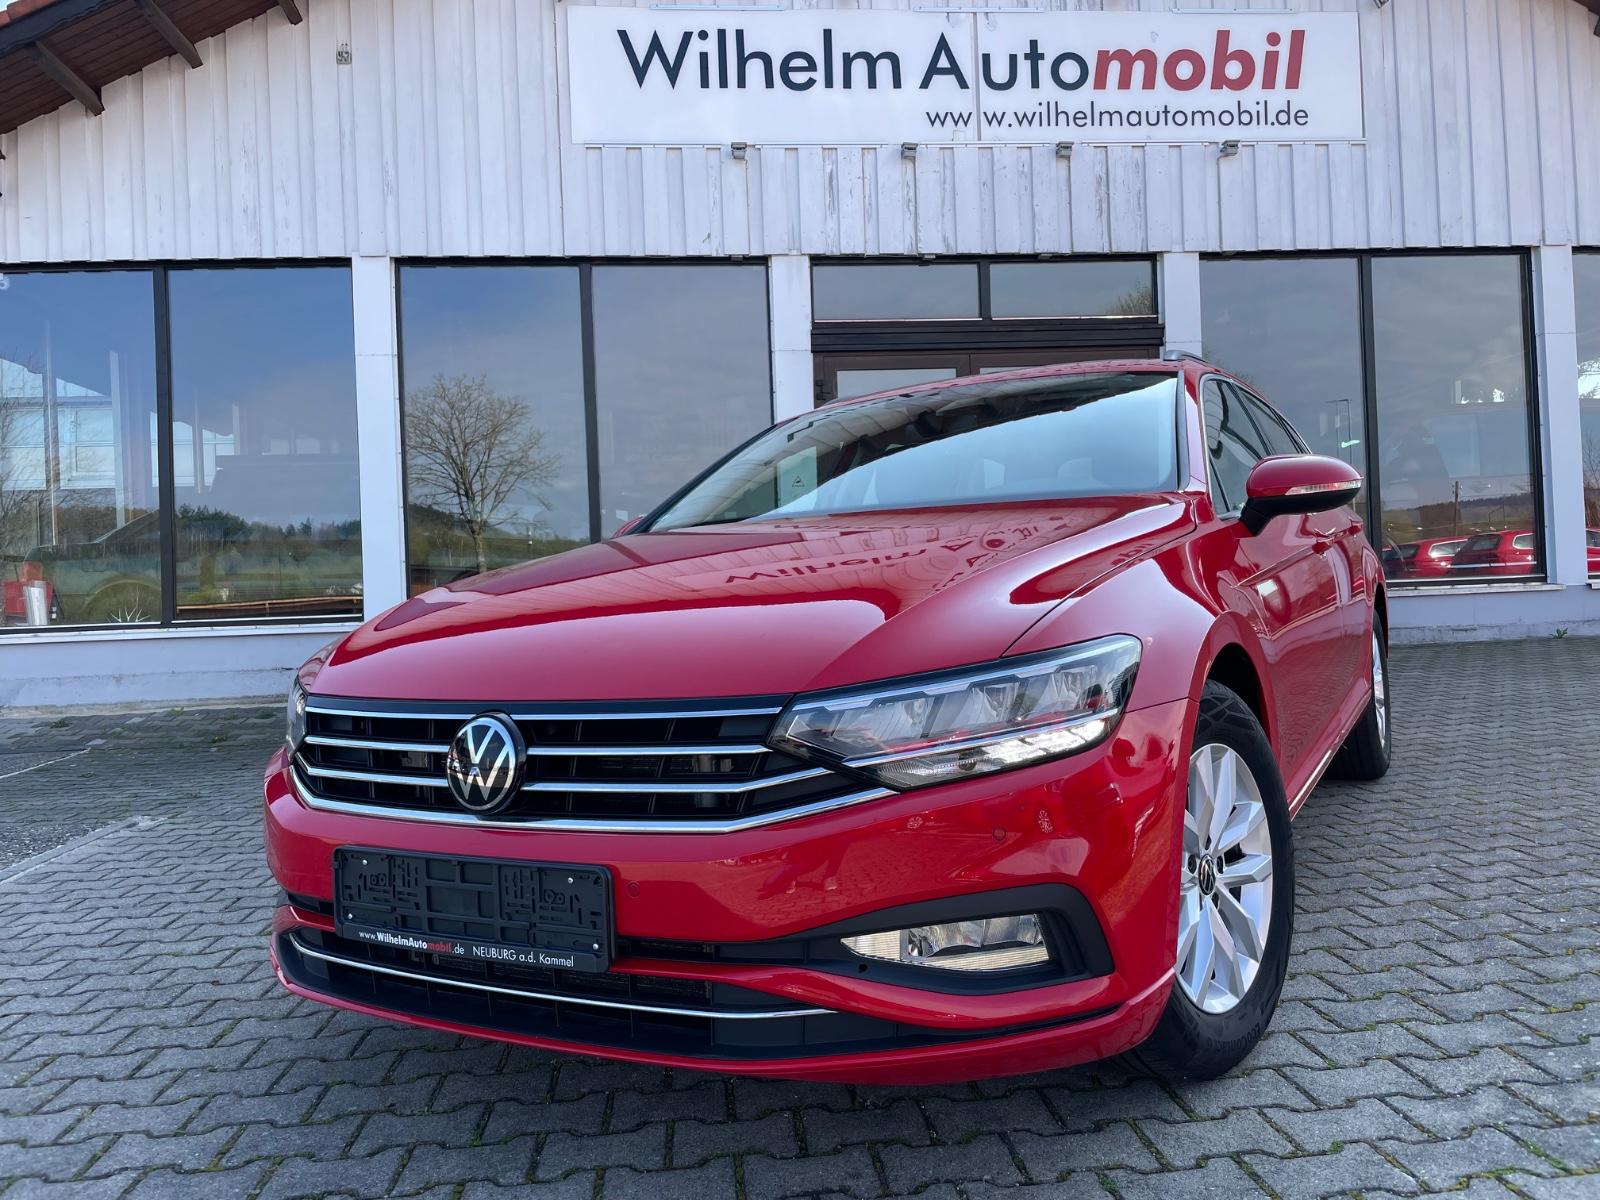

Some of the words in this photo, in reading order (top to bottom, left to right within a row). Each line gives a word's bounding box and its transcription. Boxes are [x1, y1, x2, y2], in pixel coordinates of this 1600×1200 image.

[617, 29, 902, 91] Wilhelm
[919, 29, 1306, 91] Automobil
[447, 717, 516, 810] VW
[358, 930, 465, 955] www.WilhelmAutomobil.de
[472, 946, 517, 961] NEUBURG
[519, 950, 536, 963] a.d.
[539, 953, 574, 967] Kammel
